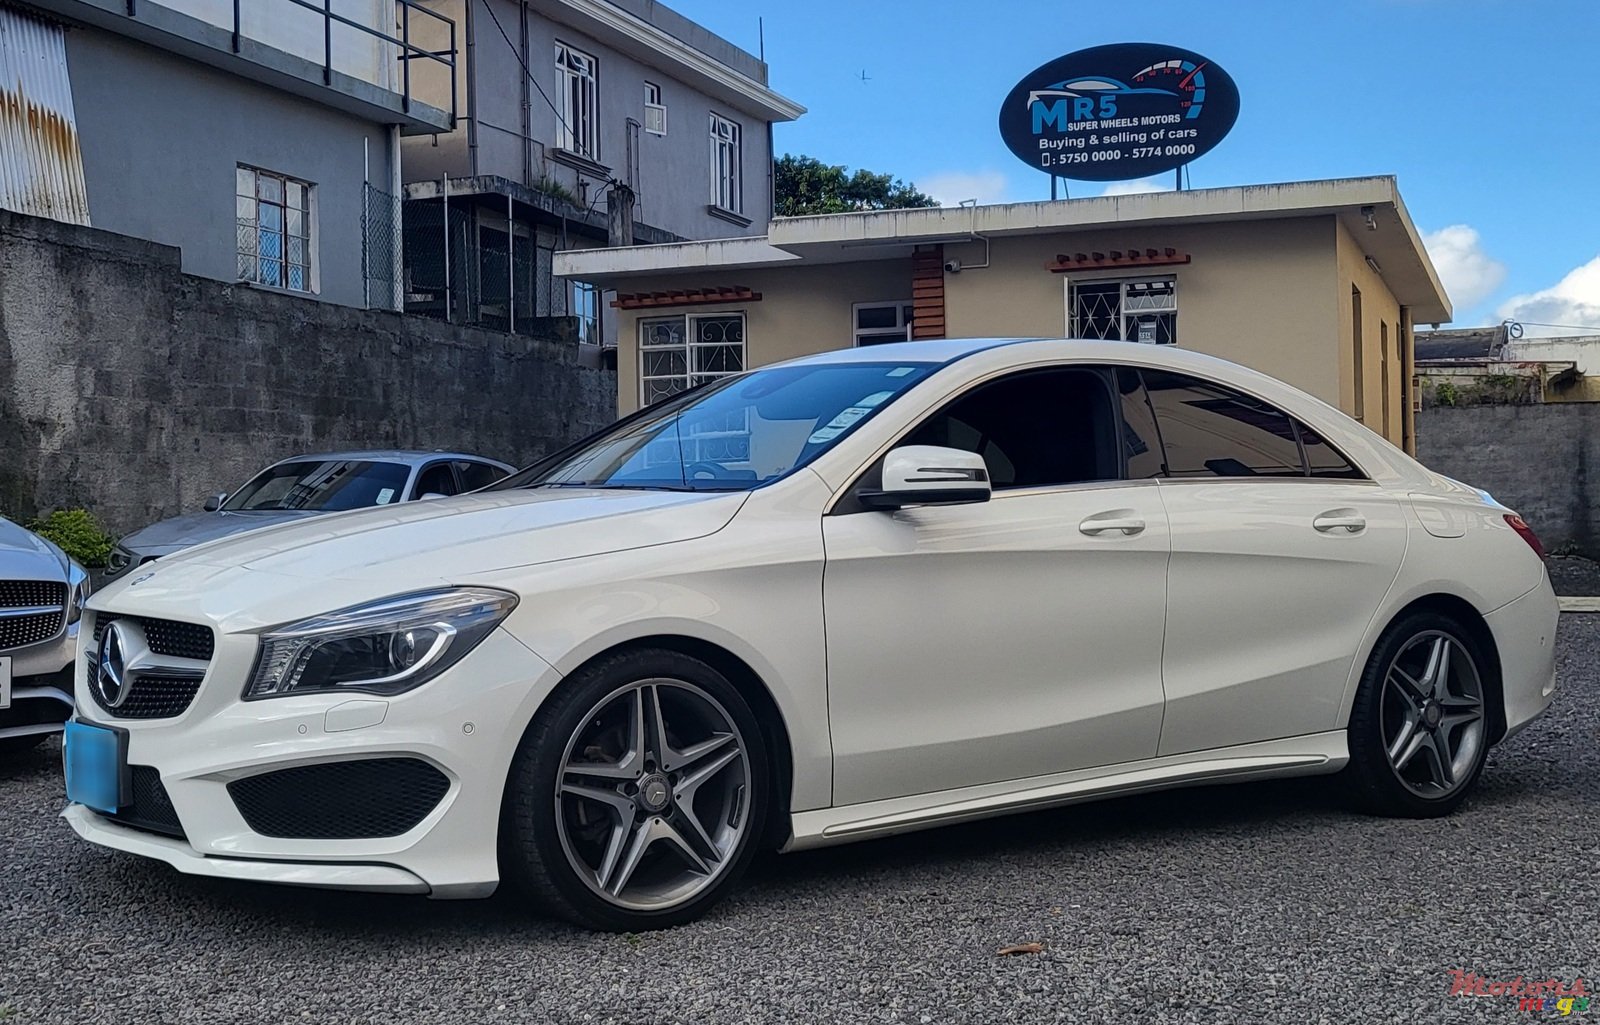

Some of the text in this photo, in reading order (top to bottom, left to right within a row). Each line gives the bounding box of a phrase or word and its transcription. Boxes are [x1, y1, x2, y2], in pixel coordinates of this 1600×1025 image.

[1067, 114, 1181, 132] SUPER WHEELS MOTORS
[1039, 128, 1198, 150] Buying & selling of cars
[1059, 152, 1089, 164] 5750
[1091, 149, 1121, 161] 0000
[1132, 146, 1162, 158] 5774
[1165, 143, 1196, 156] 0000
